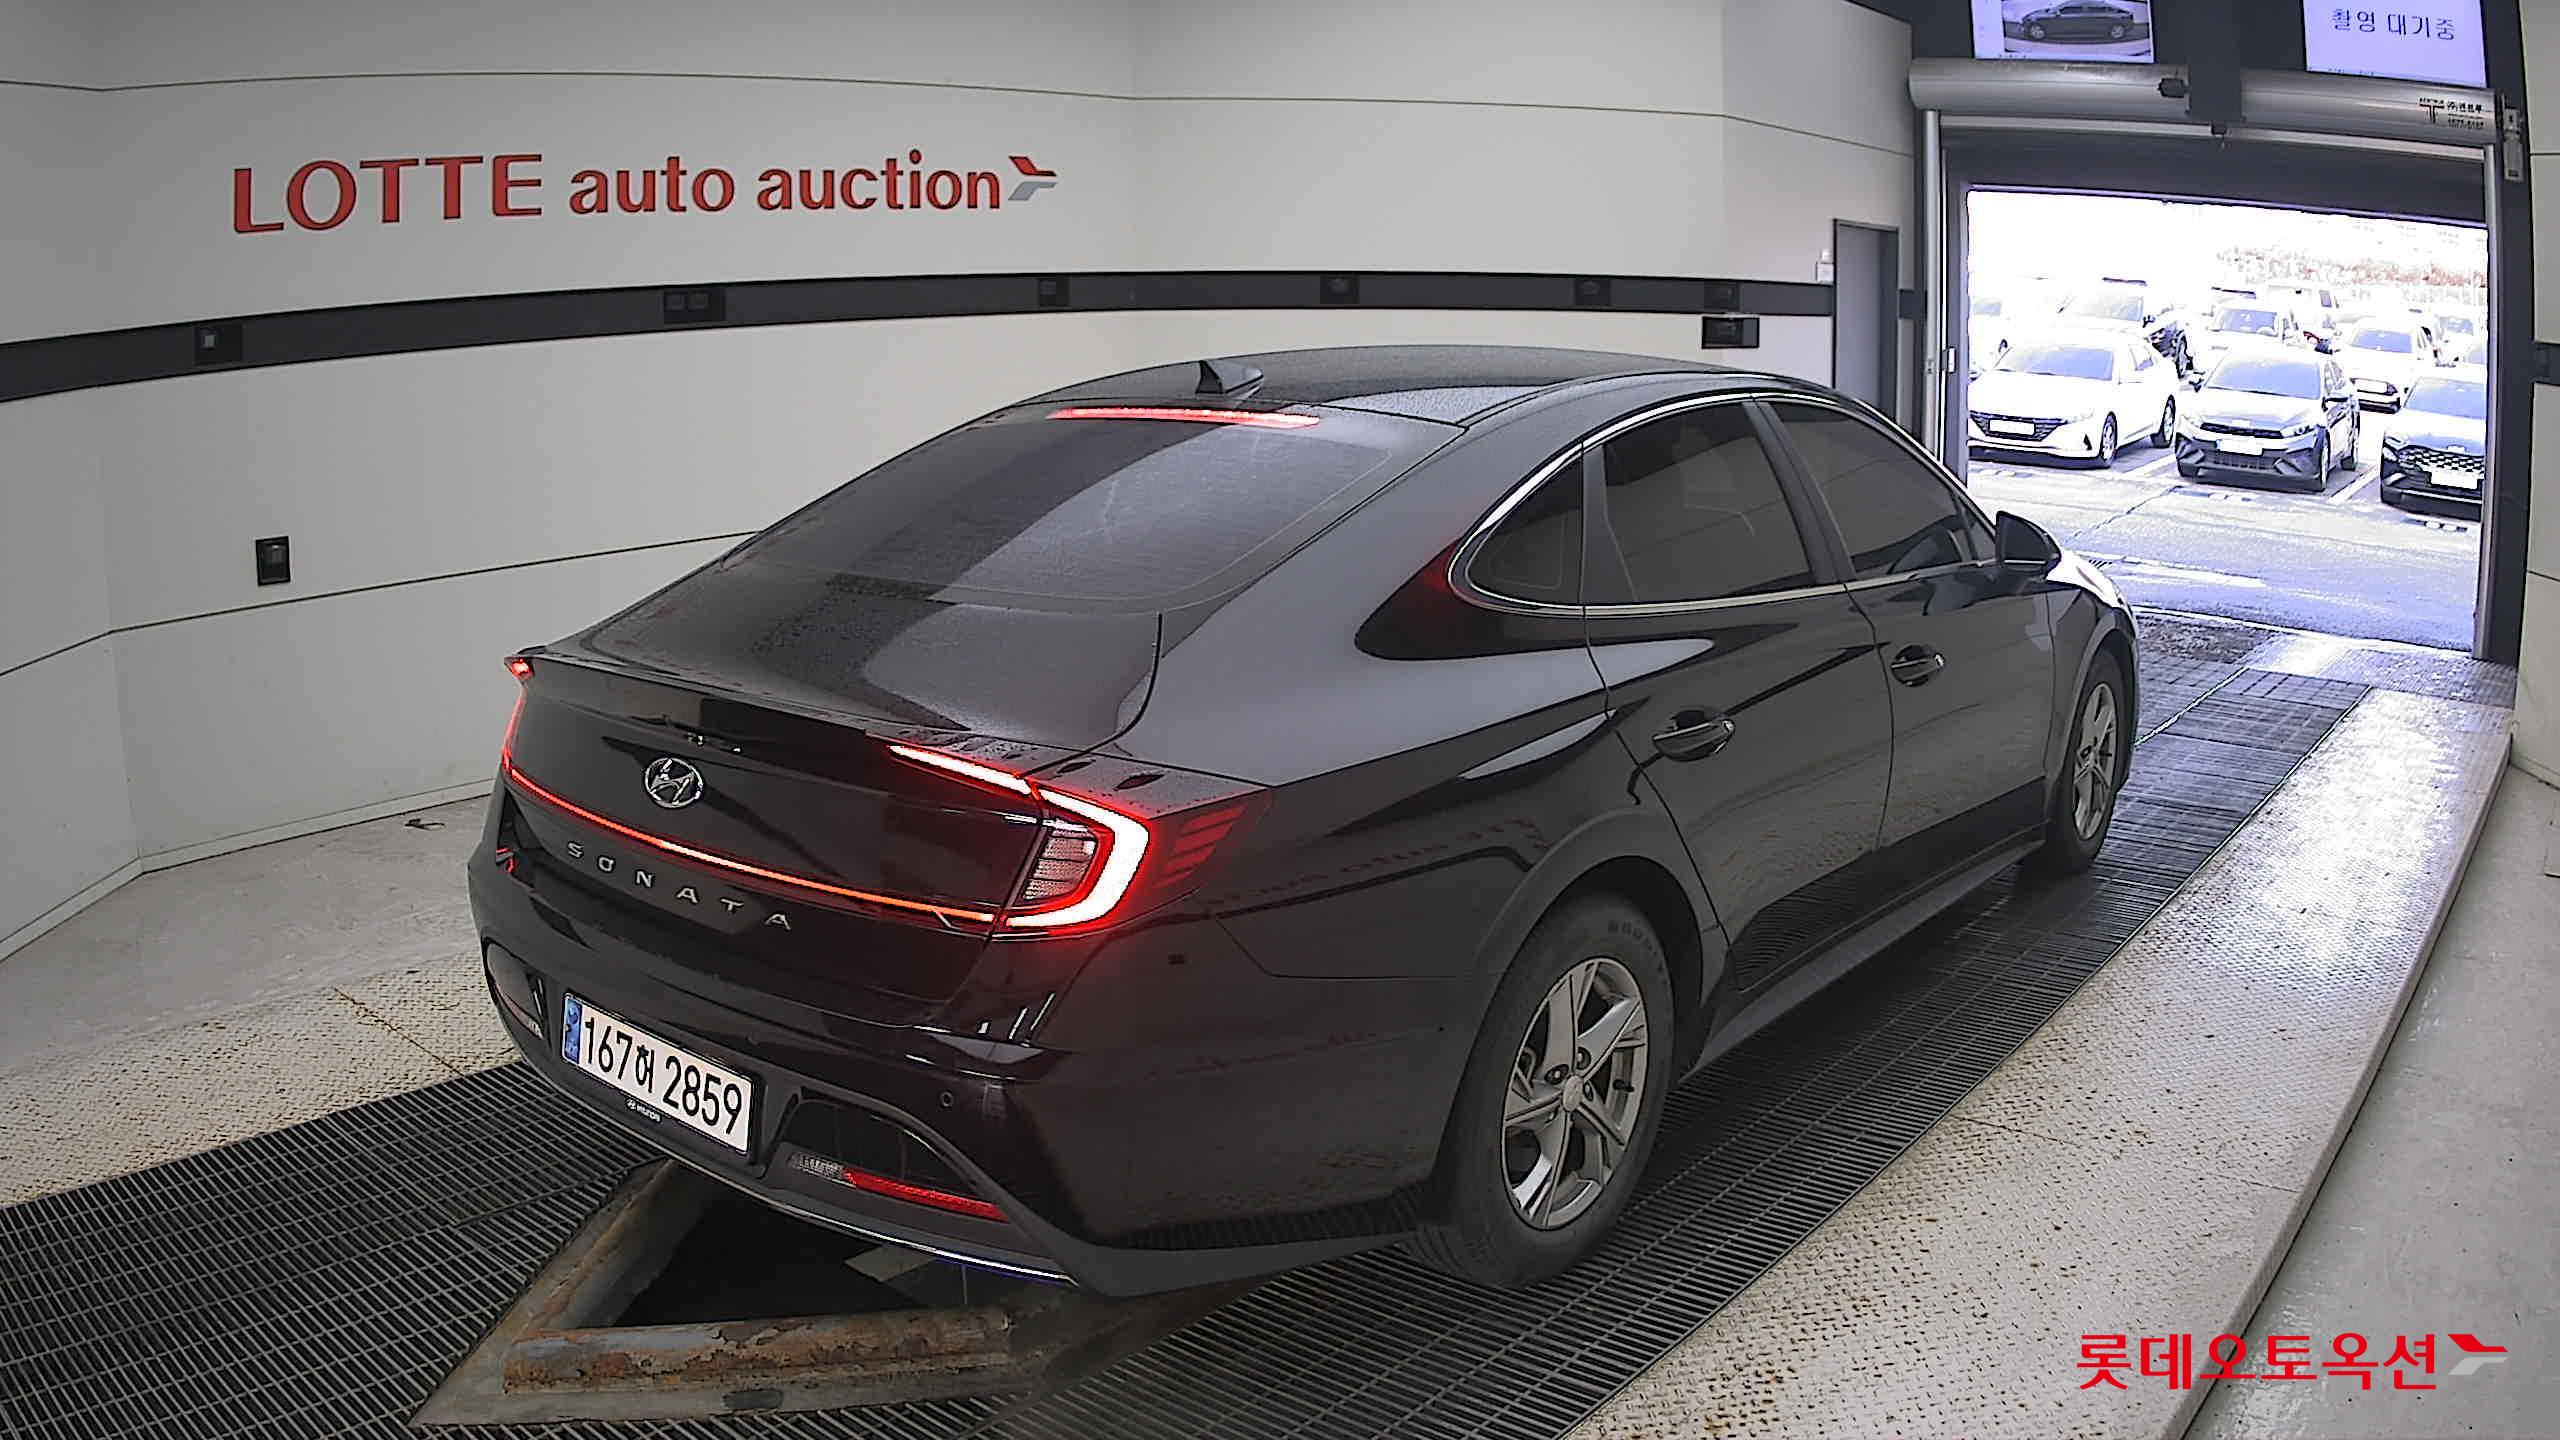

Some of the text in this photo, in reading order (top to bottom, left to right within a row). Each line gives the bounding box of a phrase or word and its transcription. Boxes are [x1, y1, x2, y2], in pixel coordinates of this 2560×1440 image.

[2387, 13, 2455, 41] 대기중
[233, 149, 1001, 234] LOTTE auto auction
[567, 842, 792, 931] SONATA
[585, 1017, 742, 1135] 167허 2859
